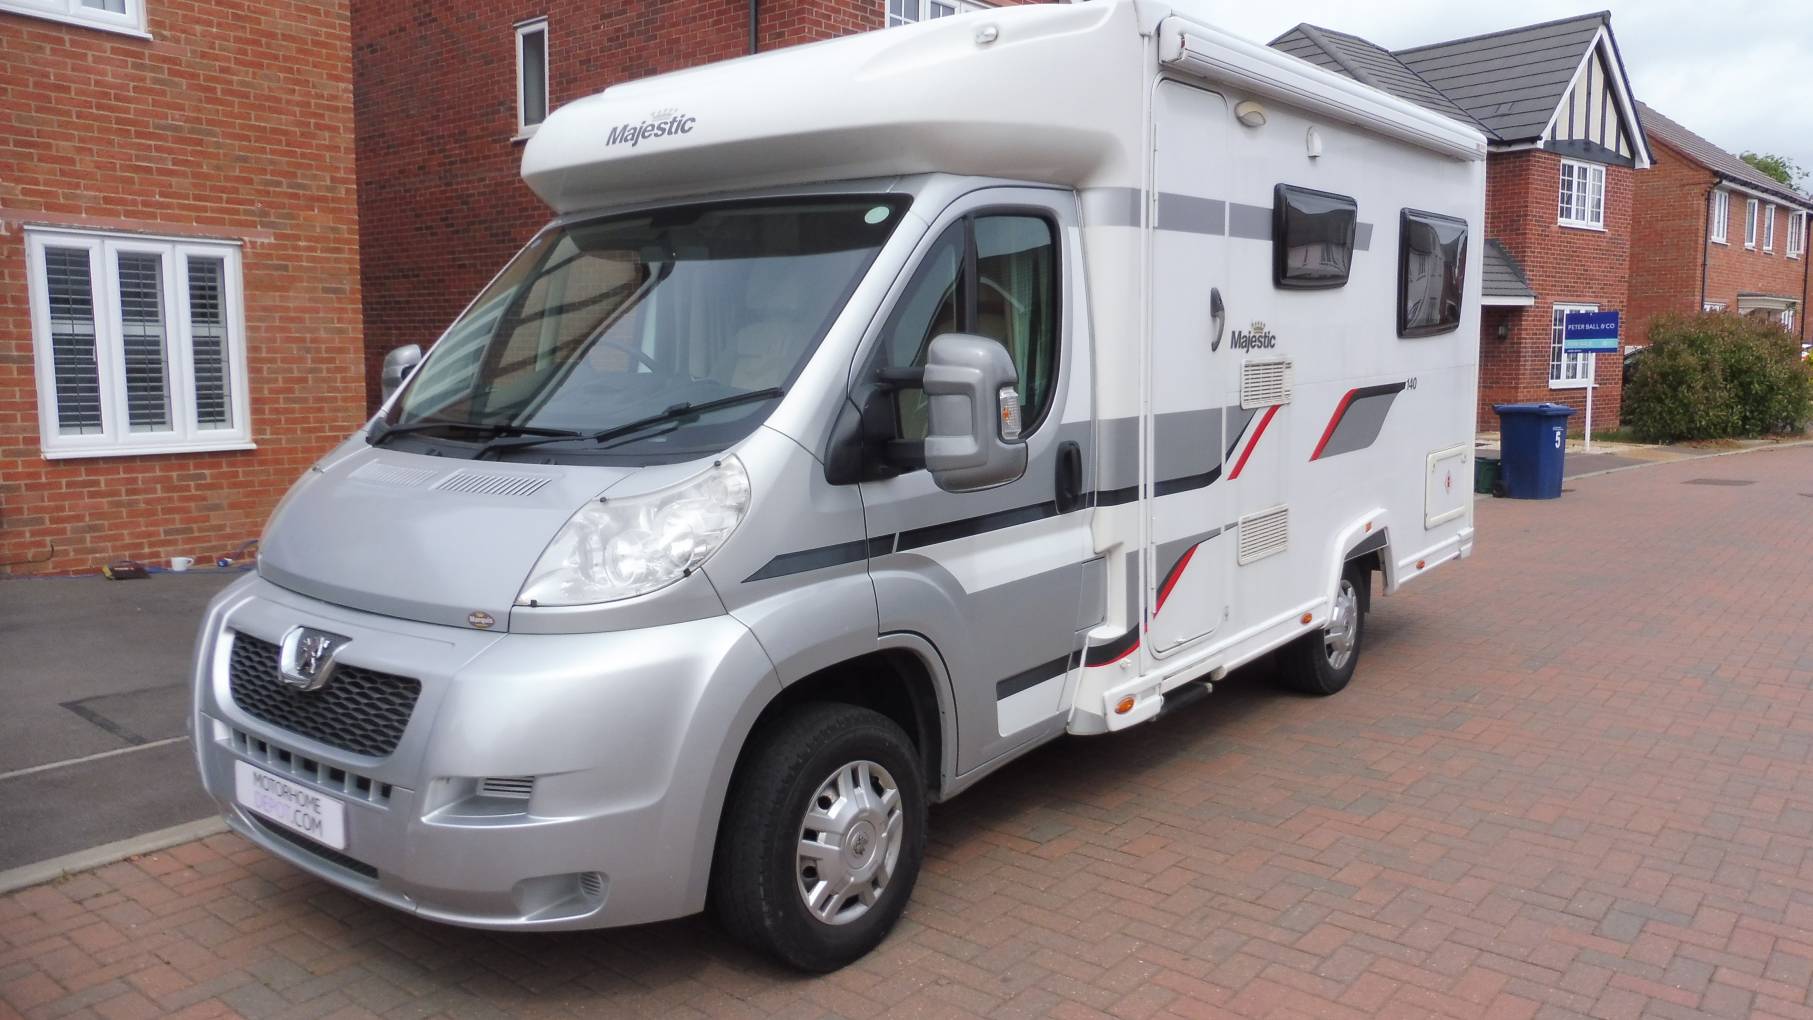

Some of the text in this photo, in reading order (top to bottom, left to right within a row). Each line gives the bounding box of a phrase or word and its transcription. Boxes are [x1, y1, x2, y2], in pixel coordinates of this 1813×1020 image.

[605, 114, 696, 147] Majestic
[1230, 330, 1276, 354] Majestic
[1555, 430, 1561, 449] 5
[252, 770, 321, 815] MOTORHOME
